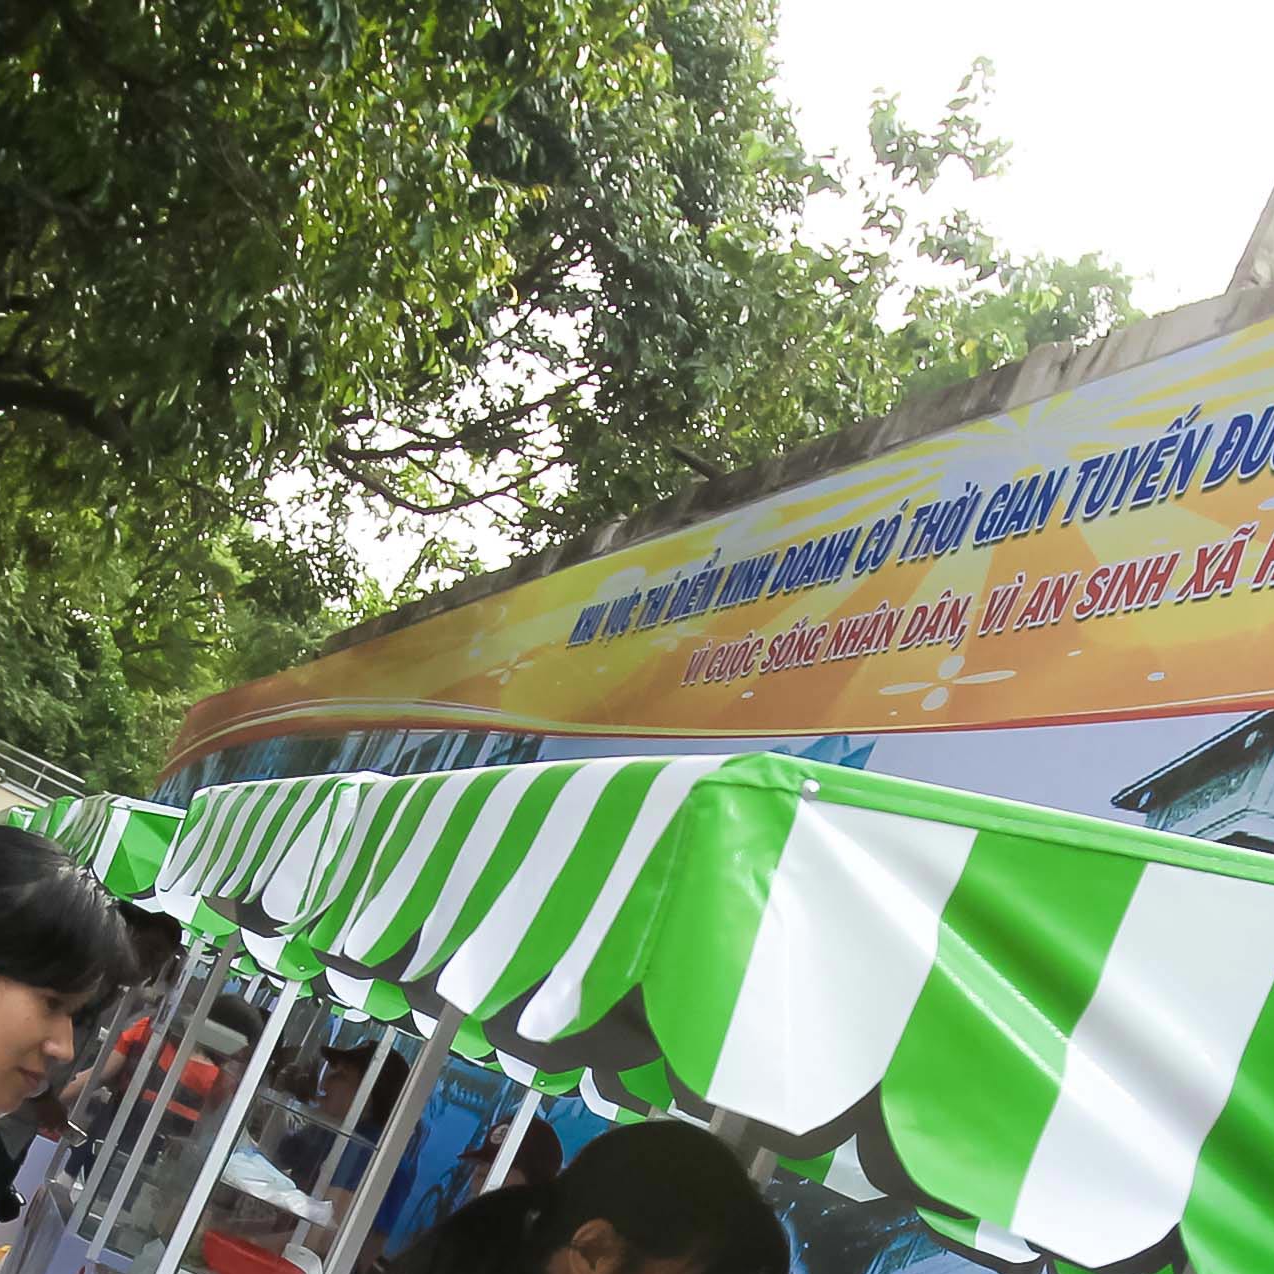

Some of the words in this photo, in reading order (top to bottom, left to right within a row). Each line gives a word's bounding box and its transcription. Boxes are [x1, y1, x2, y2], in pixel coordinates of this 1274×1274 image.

[566, 601, 610, 646] KHU
[664, 546, 725, 621] ĐIỂM
[716, 550, 779, 607] KINH
[768, 525, 863, 596] DOANH
[853, 498, 910, 574] CÓ
[898, 481, 983, 562] THỜI
[973, 464, 1070, 544] GIAN
[1061, 402, 1214, 524] TUYẾN
[681, 640, 711, 686] VÌ
[703, 629, 764, 687] CUỘC
[759, 615, 828, 673] SỐNG
[821, 600, 905, 662] NHÂN
[897, 588, 973, 650] DÂN,
[977, 572, 1025, 636] VÌ
[1014, 573, 1078, 629] AN
[1074, 550, 1181, 620] SINH
[1176, 521, 1258, 603] XÃ
